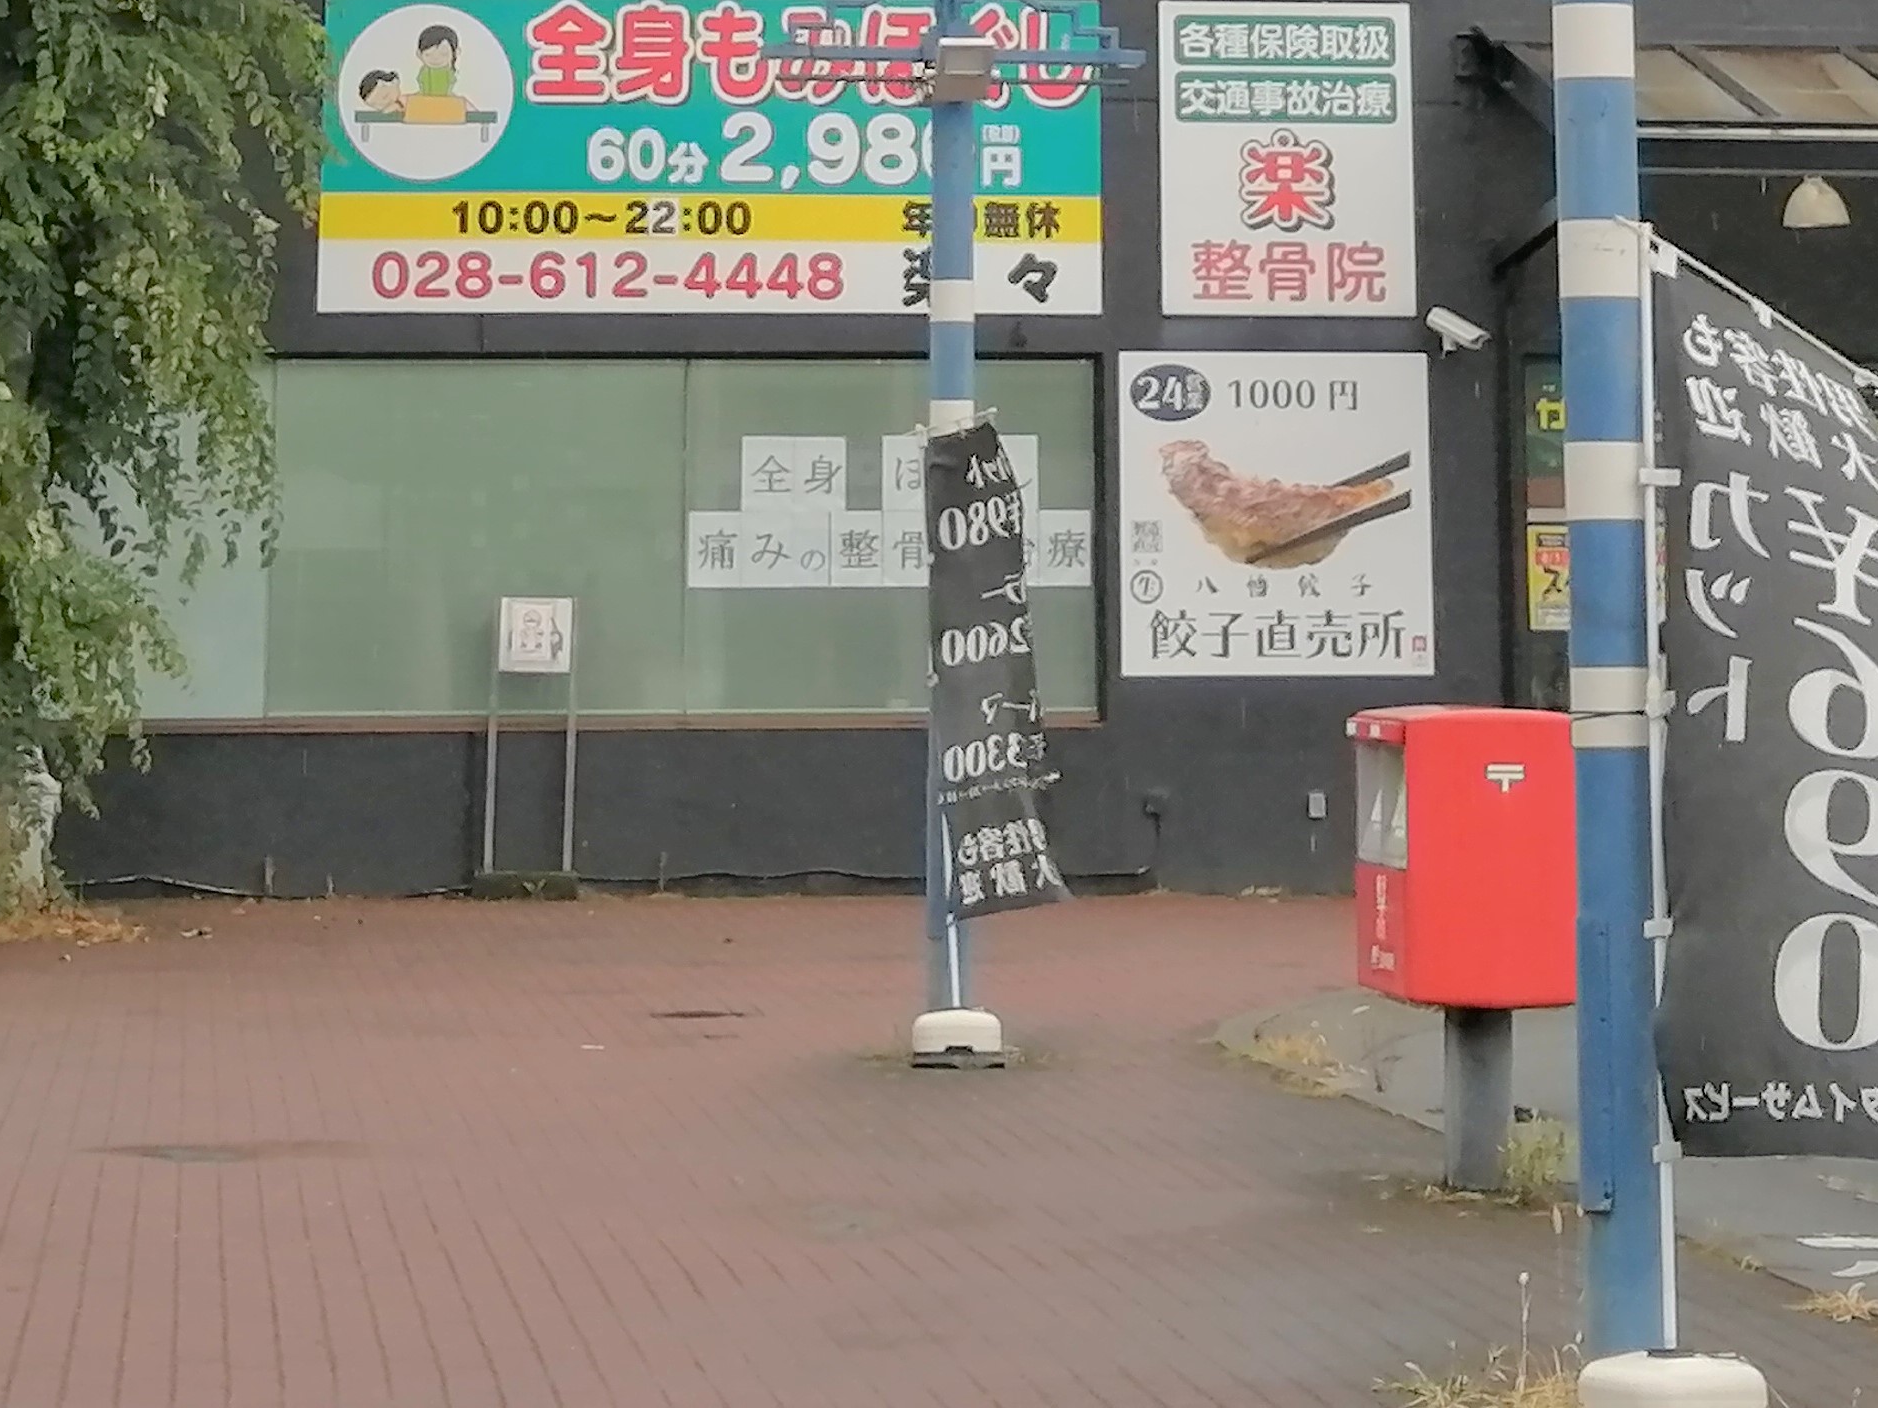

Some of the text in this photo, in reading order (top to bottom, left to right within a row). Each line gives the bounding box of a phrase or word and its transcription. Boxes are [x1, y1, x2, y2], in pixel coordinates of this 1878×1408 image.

[1179, 22, 1390, 60] 各種保険取扱
[1179, 79, 1392, 117] 交通事故治療
[586, 112, 1022, 190] 60分 2,98円
[1239, 128, 1336, 232] 楽
[902, 200, 1061, 238] 年無休
[371, 251, 845, 300] 028-612-4448
[1191, 239, 1387, 303] 整骨院
[1228, 379, 1359, 411] 1000円
[698, 529, 1086, 572] 痛みの整骨療
[1149, 609, 1407, 660] 餃子直売所
